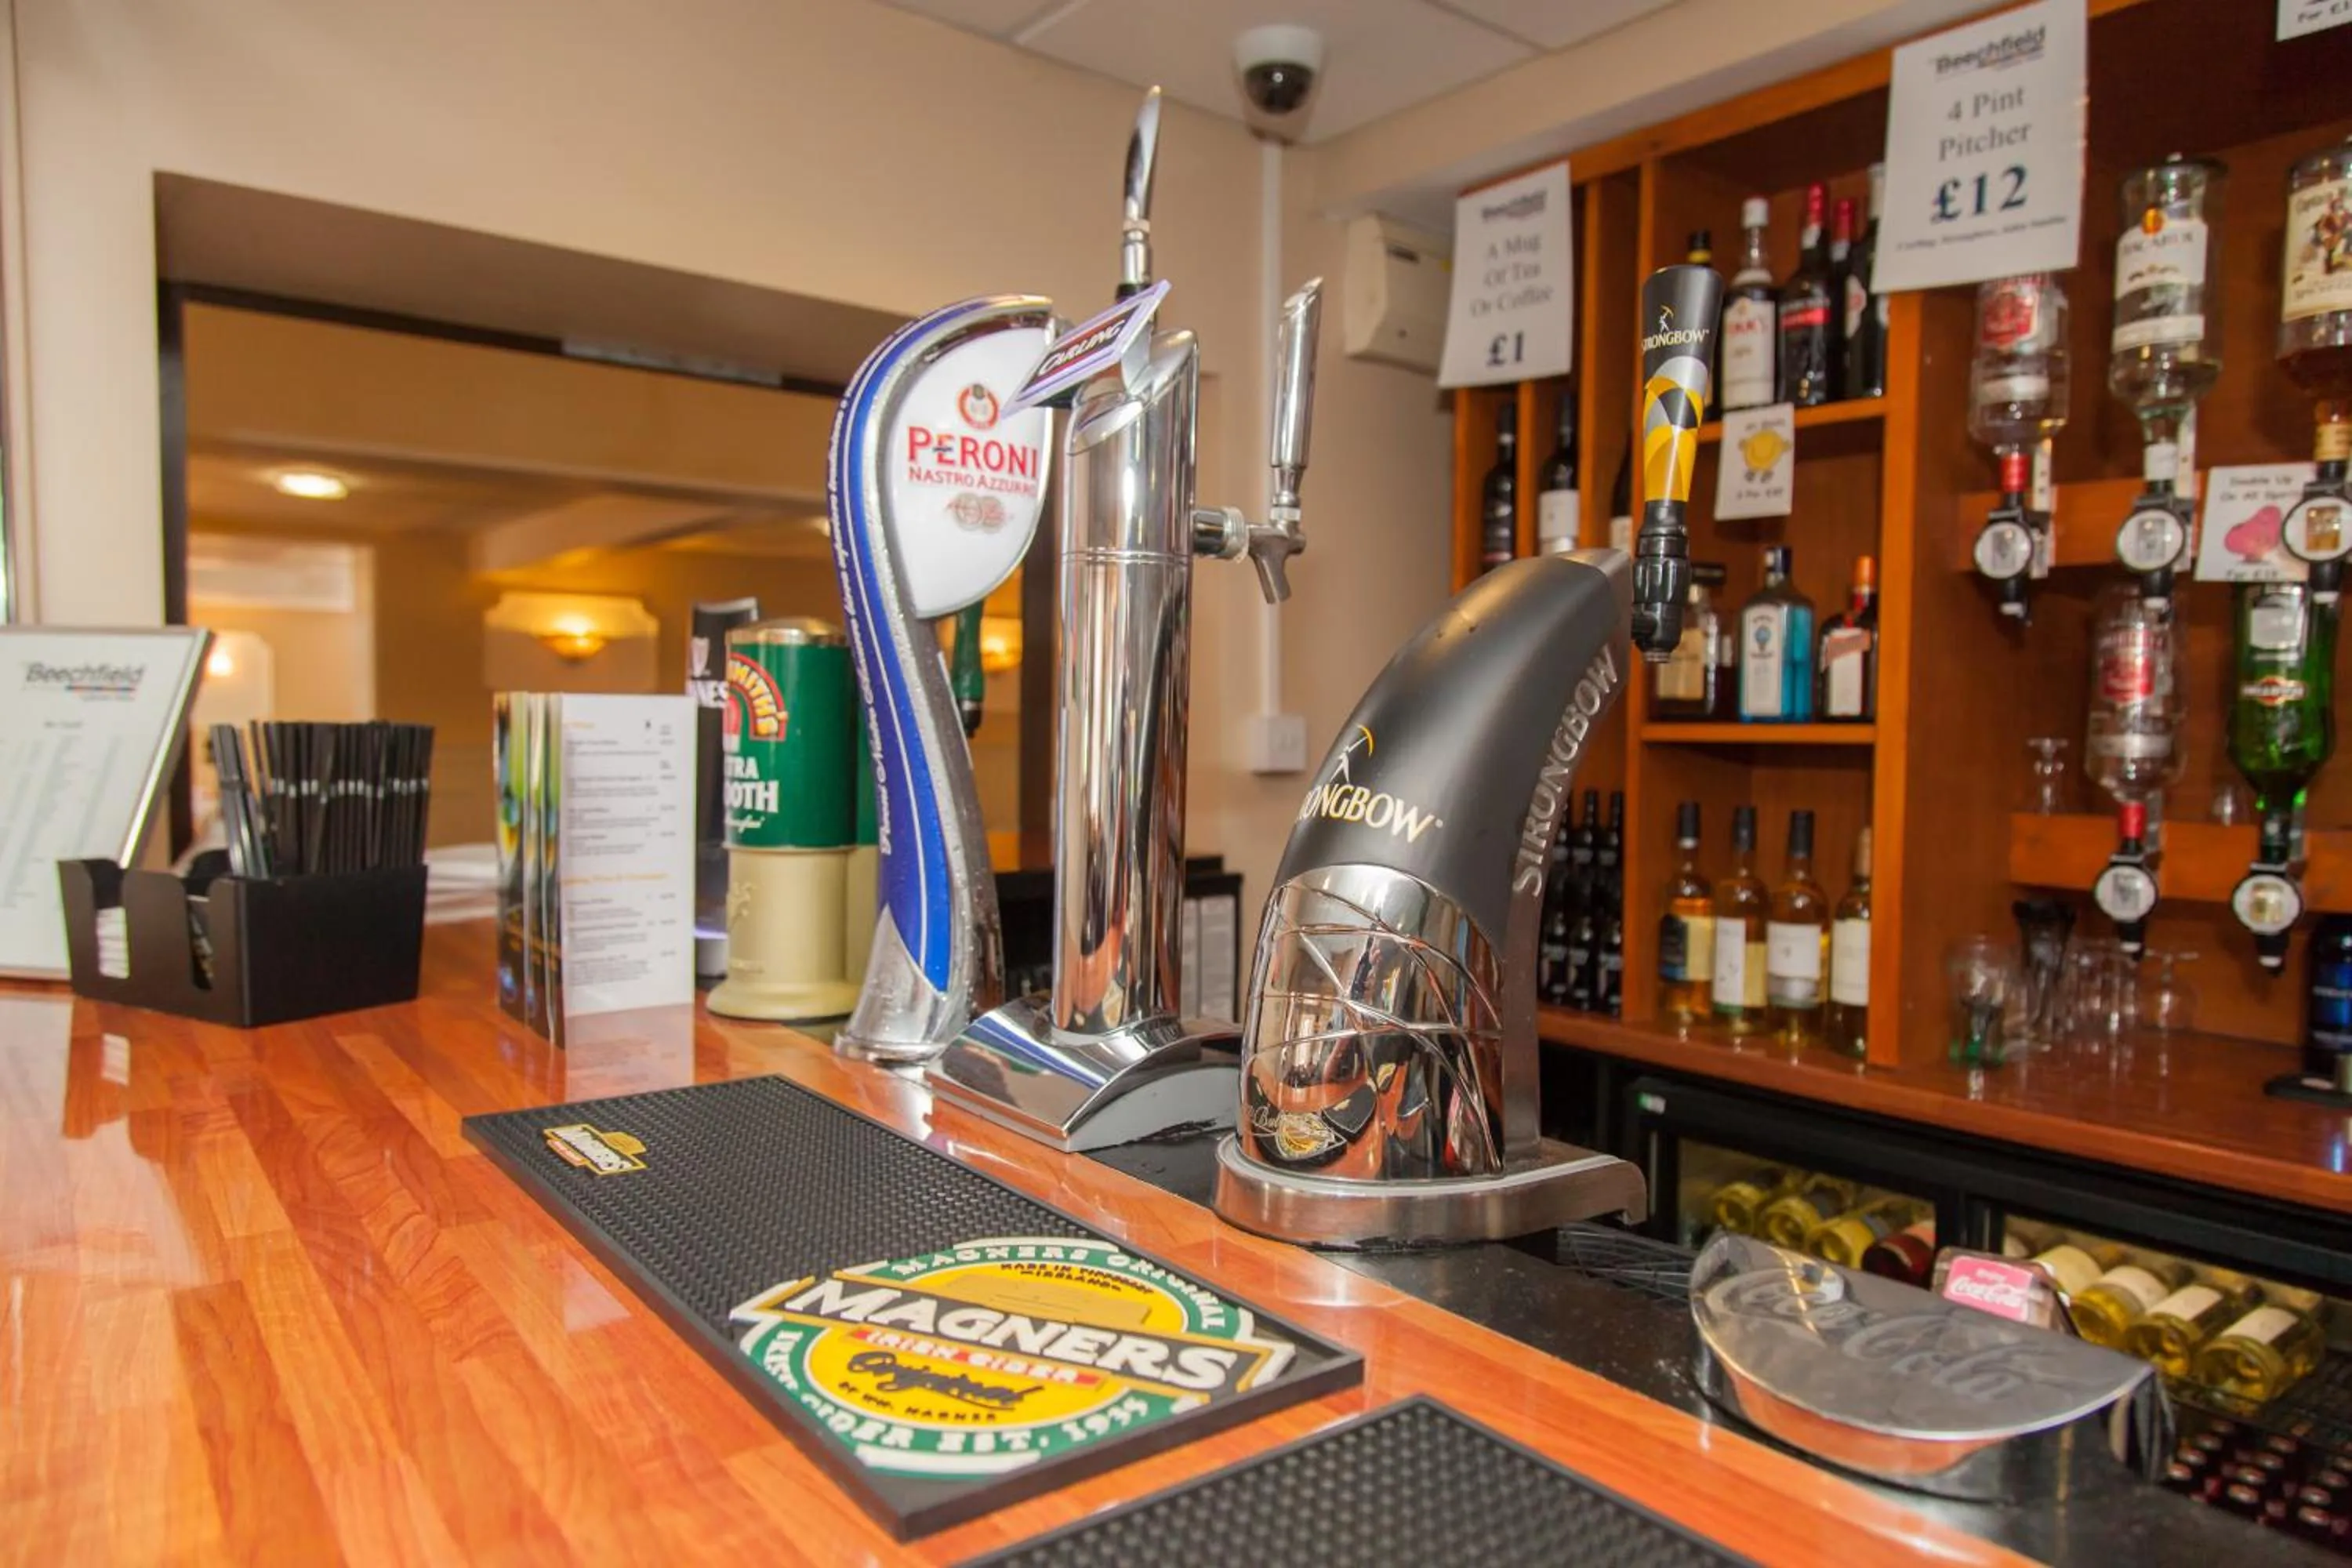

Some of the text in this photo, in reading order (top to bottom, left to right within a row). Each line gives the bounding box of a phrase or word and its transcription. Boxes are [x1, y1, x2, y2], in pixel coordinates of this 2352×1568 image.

[1936, 26, 2045, 74] Beechfield
[1947, 86, 2024, 122] 4 Pint
[1939, 123, 2032, 162] Pitcher
[1930, 163, 2028, 225] £12
[1488, 234, 1542, 260] A Mug
[1512, 263, 1541, 281] Tea
[1497, 285, 1554, 312] Coffee
[1038, 319, 1126, 376] CARLING
[1486, 330, 1524, 368] £1
[908, 426, 1037, 480] PERONI
[908, 466, 1037, 498] NASTRO AZZURRO
[26, 661, 146, 683] Beechfield
[1513, 643, 1618, 898] STRONGBOW
[891, 1245, 1226, 1330] MAGNERS ORIGINAL
[1950, 1274, 2023, 1308] Coca-Cola
[785, 1277, 1237, 1390] MAGNERS
[866, 1330, 1079, 1385] IRISH CIDER
[800, 1392, 915, 1449] CIDER
[936, 1430, 1049, 1452] EST.
